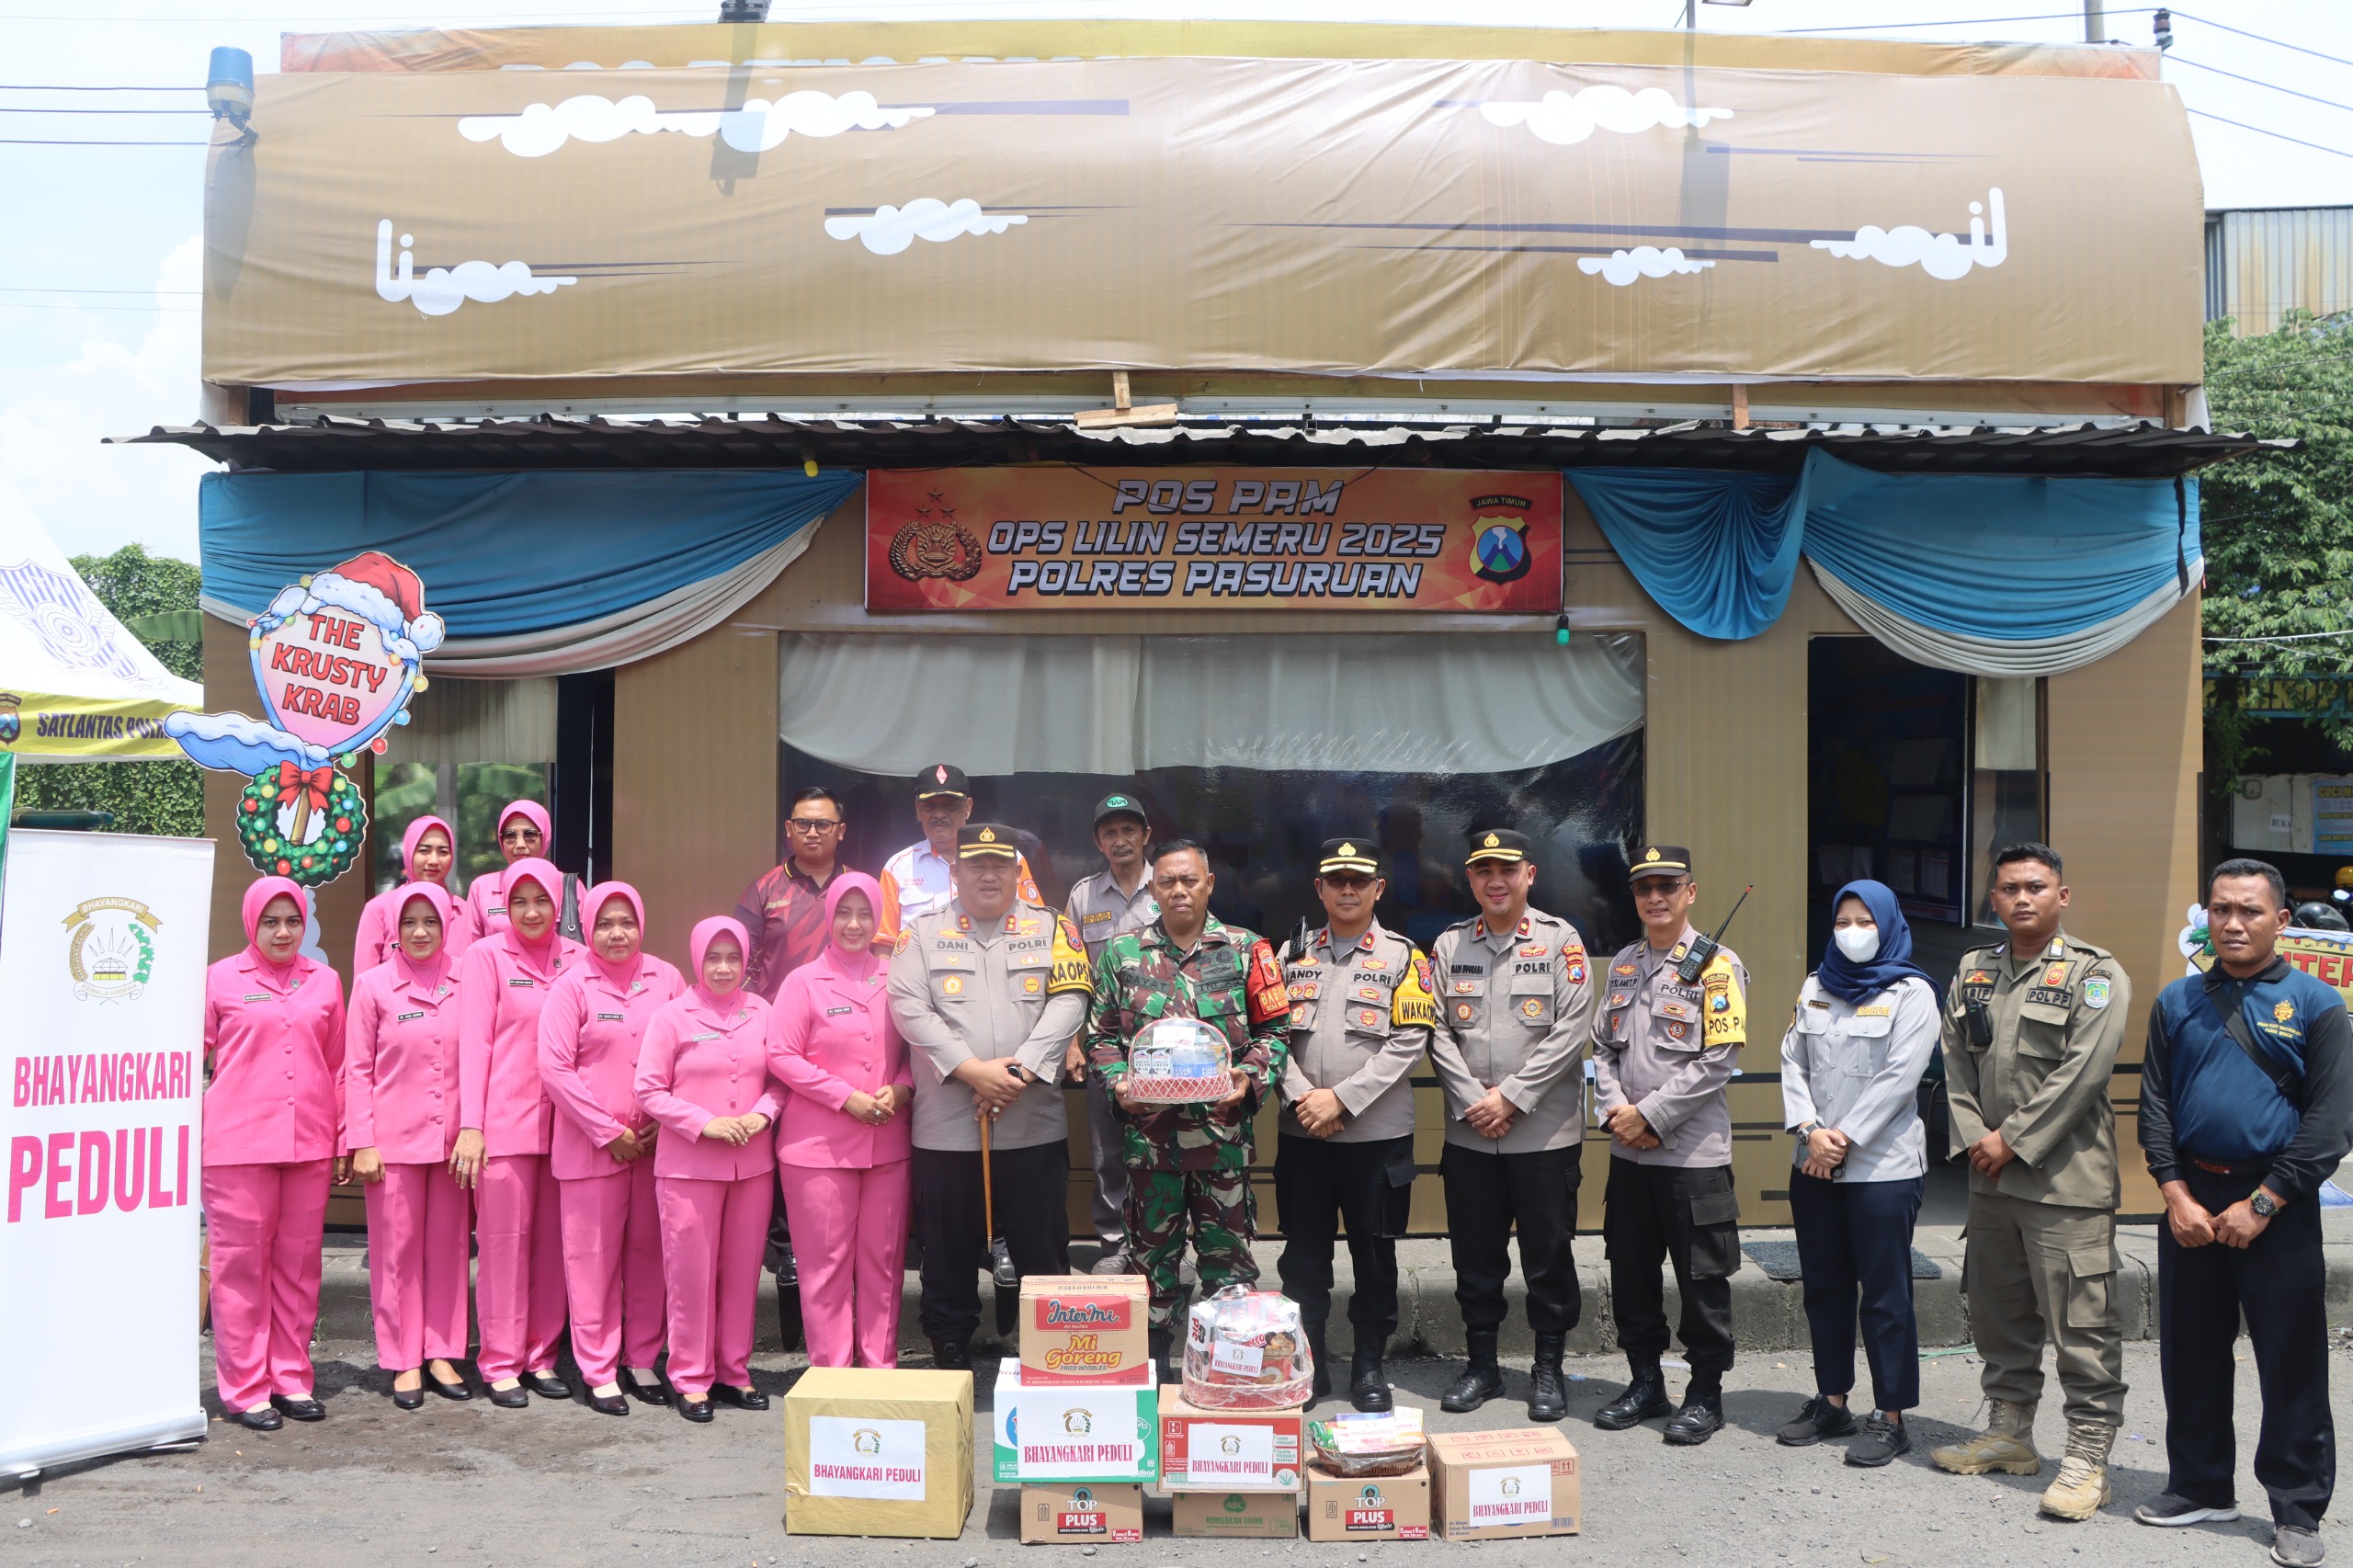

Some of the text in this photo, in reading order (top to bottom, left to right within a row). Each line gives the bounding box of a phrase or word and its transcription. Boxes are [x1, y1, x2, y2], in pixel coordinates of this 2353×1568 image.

[1111, 479, 1344, 516] POS PAM
[1476, 497, 1527, 507] JAWA TIMUR
[986, 521, 1447, 557] OPS LILIN SEMERU 2025
[1006, 560, 1424, 598] POLRES PASURUAN
[308, 613, 365, 651] THE
[271, 642, 388, 693] KRUSTY
[282, 683, 360, 725] KRAB
[37, 713, 124, 739] SATLANTAS
[82, 898, 145, 913] BHAYANGKARI
[937, 939, 1047, 951] DANI POLRI
[1516, 962, 1551, 973] POLRI
[1198, 982, 1217, 992] TNI
[1353, 973, 1391, 984] POLRI
[81, 983, 137, 996] KEMALA HIKMAH
[1660, 983, 1699, 1001] POLRI
[2029, 991, 2068, 1005] POL PP
[1709, 1017, 1728, 1034] POS
[13, 1051, 192, 1108] BHAYANGKARI
[7, 1124, 190, 1223] PEDULI
[1067, 1335, 1098, 1352] Mi
[1045, 1349, 1122, 1369] Goreng
[1024, 1444, 1132, 1463] BHAYANGKARI PEDULI
[814, 1464, 921, 1482] BHAYANGKARI PEDULI
[1192, 1460, 1241, 1473] BHAYANGKARI
[1244, 1461, 1268, 1474] PEDULI
[1066, 1500, 1098, 1511] TOP
[1354, 1496, 1386, 1508] TOP
[1473, 1500, 1548, 1517] BHAYANGKARI PEDULI
[1065, 1514, 1097, 1526] PLUS
[1353, 1511, 1385, 1524] PLUS
